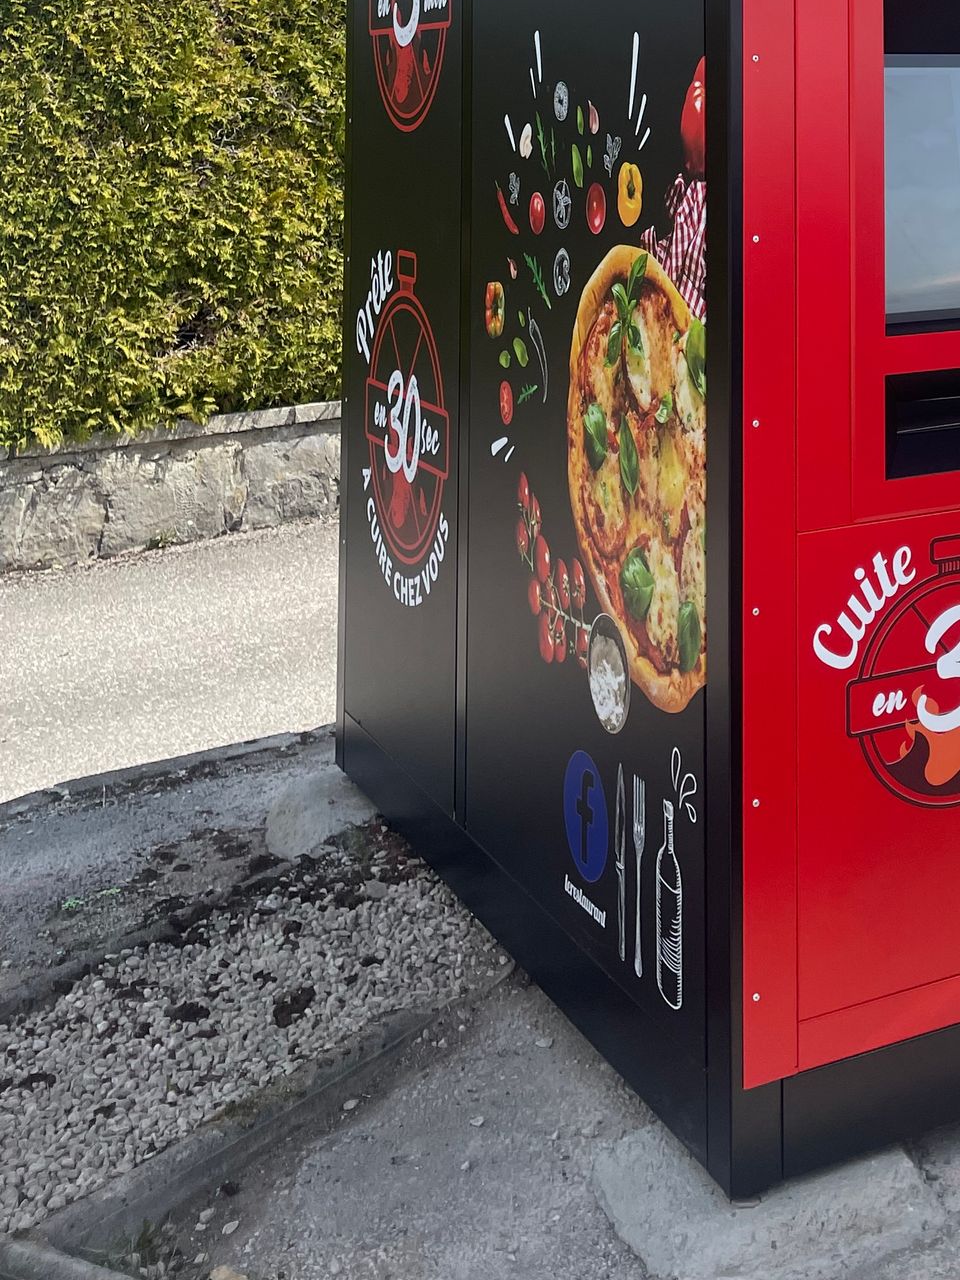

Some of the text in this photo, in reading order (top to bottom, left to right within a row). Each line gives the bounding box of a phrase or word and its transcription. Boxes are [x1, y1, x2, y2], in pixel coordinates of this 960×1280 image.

[356, 249, 394, 364] Prête
[373, 369, 440, 484] en 30 sec
[366, 496, 393, 588] CUIRE
[393, 570, 424, 607] CHEZ
[421, 511, 450, 595] VOUS
[812, 543, 917, 672] Cuite
[872, 688, 907, 718] en
